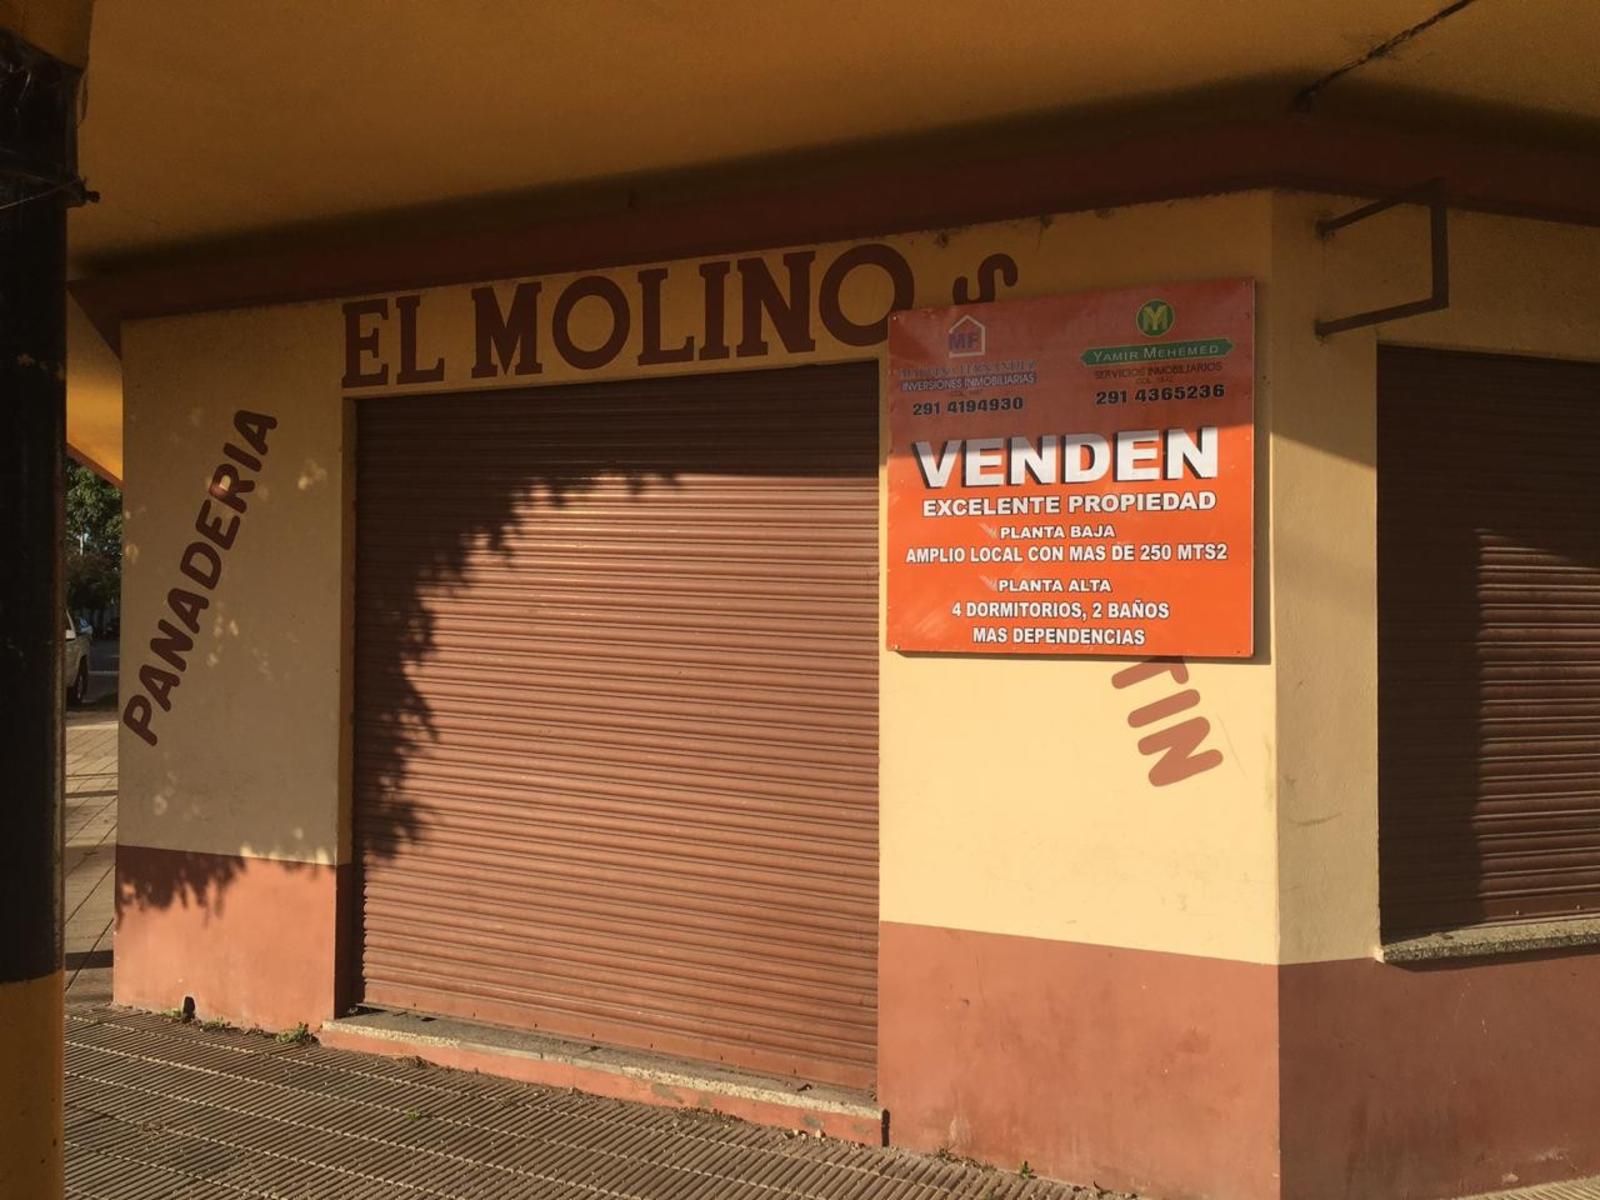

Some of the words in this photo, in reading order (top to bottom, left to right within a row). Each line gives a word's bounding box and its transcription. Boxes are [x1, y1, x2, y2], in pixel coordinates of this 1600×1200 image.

[341, 295, 445, 389] EL
[471, 243, 915, 380] MOLINO
[948, 332, 978, 350] MF
[1093, 350, 1138, 362] YAMIR
[1143, 344, 1219, 359] MEHEMED
[1094, 367, 1145, 380] SERVICIOS
[1147, 361, 1223, 376] INMOBILIARIOS
[902, 377, 962, 392] INVERSIONES
[964, 372, 1036, 389] INMOBILIARIAS
[1095, 390, 1127, 405] 291
[1135, 384, 1225, 403] 4365236
[912, 402, 940, 416] 291
[947, 396, 1024, 413] 4194930
[913, 426, 1218, 489] VENDEN
[922, 494, 1060, 517] EXCELENTE
[1068, 491, 1217, 513] PROPIEDAD
[1000, 525, 1065, 539] PLANTA
[1070, 525, 1116, 539] BAJA
[905, 548, 965, 563] AMPLIO
[970, 547, 1023, 562] LOCAL
[1028, 546, 1064, 562] CON
[1069, 546, 1105, 561] MAS
[1111, 545, 1135, 561] DE
[1139, 545, 1172, 561] 250
[1177, 543, 1228, 560] MTS2
[122, 409, 278, 746] PANADERIA
[998, 579, 1063, 593] PLANTA
[1068, 579, 1111, 592] ALTA
[952, 602, 962, 617] 4
[966, 602, 1087, 621] DORMITORIOS,
[1092, 603, 1102, 618] 2
[1108, 599, 1170, 619] BAÑOS
[972, 628, 1007, 643] MAS
[1012, 628, 1146, 646] DEPENDENCIAS
[1111, 656, 1224, 787] TIN
